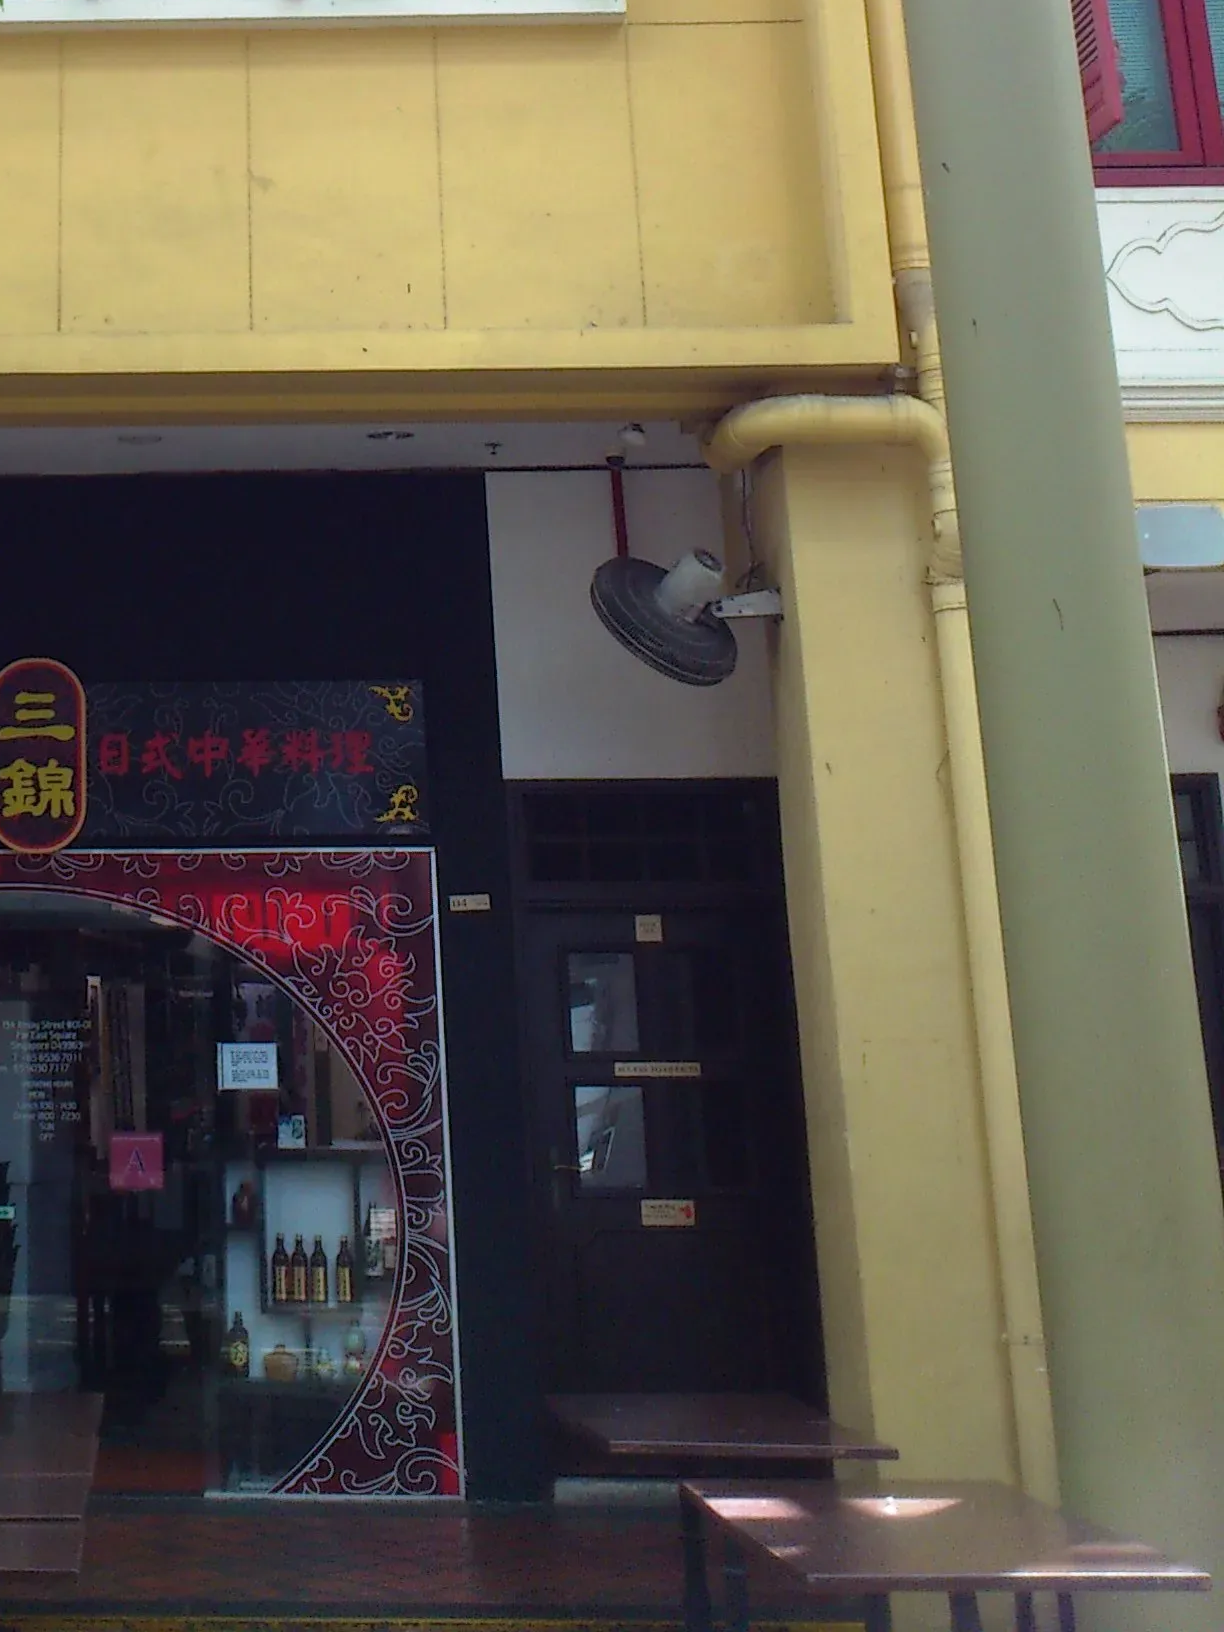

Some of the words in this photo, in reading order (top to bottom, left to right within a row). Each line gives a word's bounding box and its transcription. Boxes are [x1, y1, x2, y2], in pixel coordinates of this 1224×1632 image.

[99, 728, 374, 780] 日式中華料理
